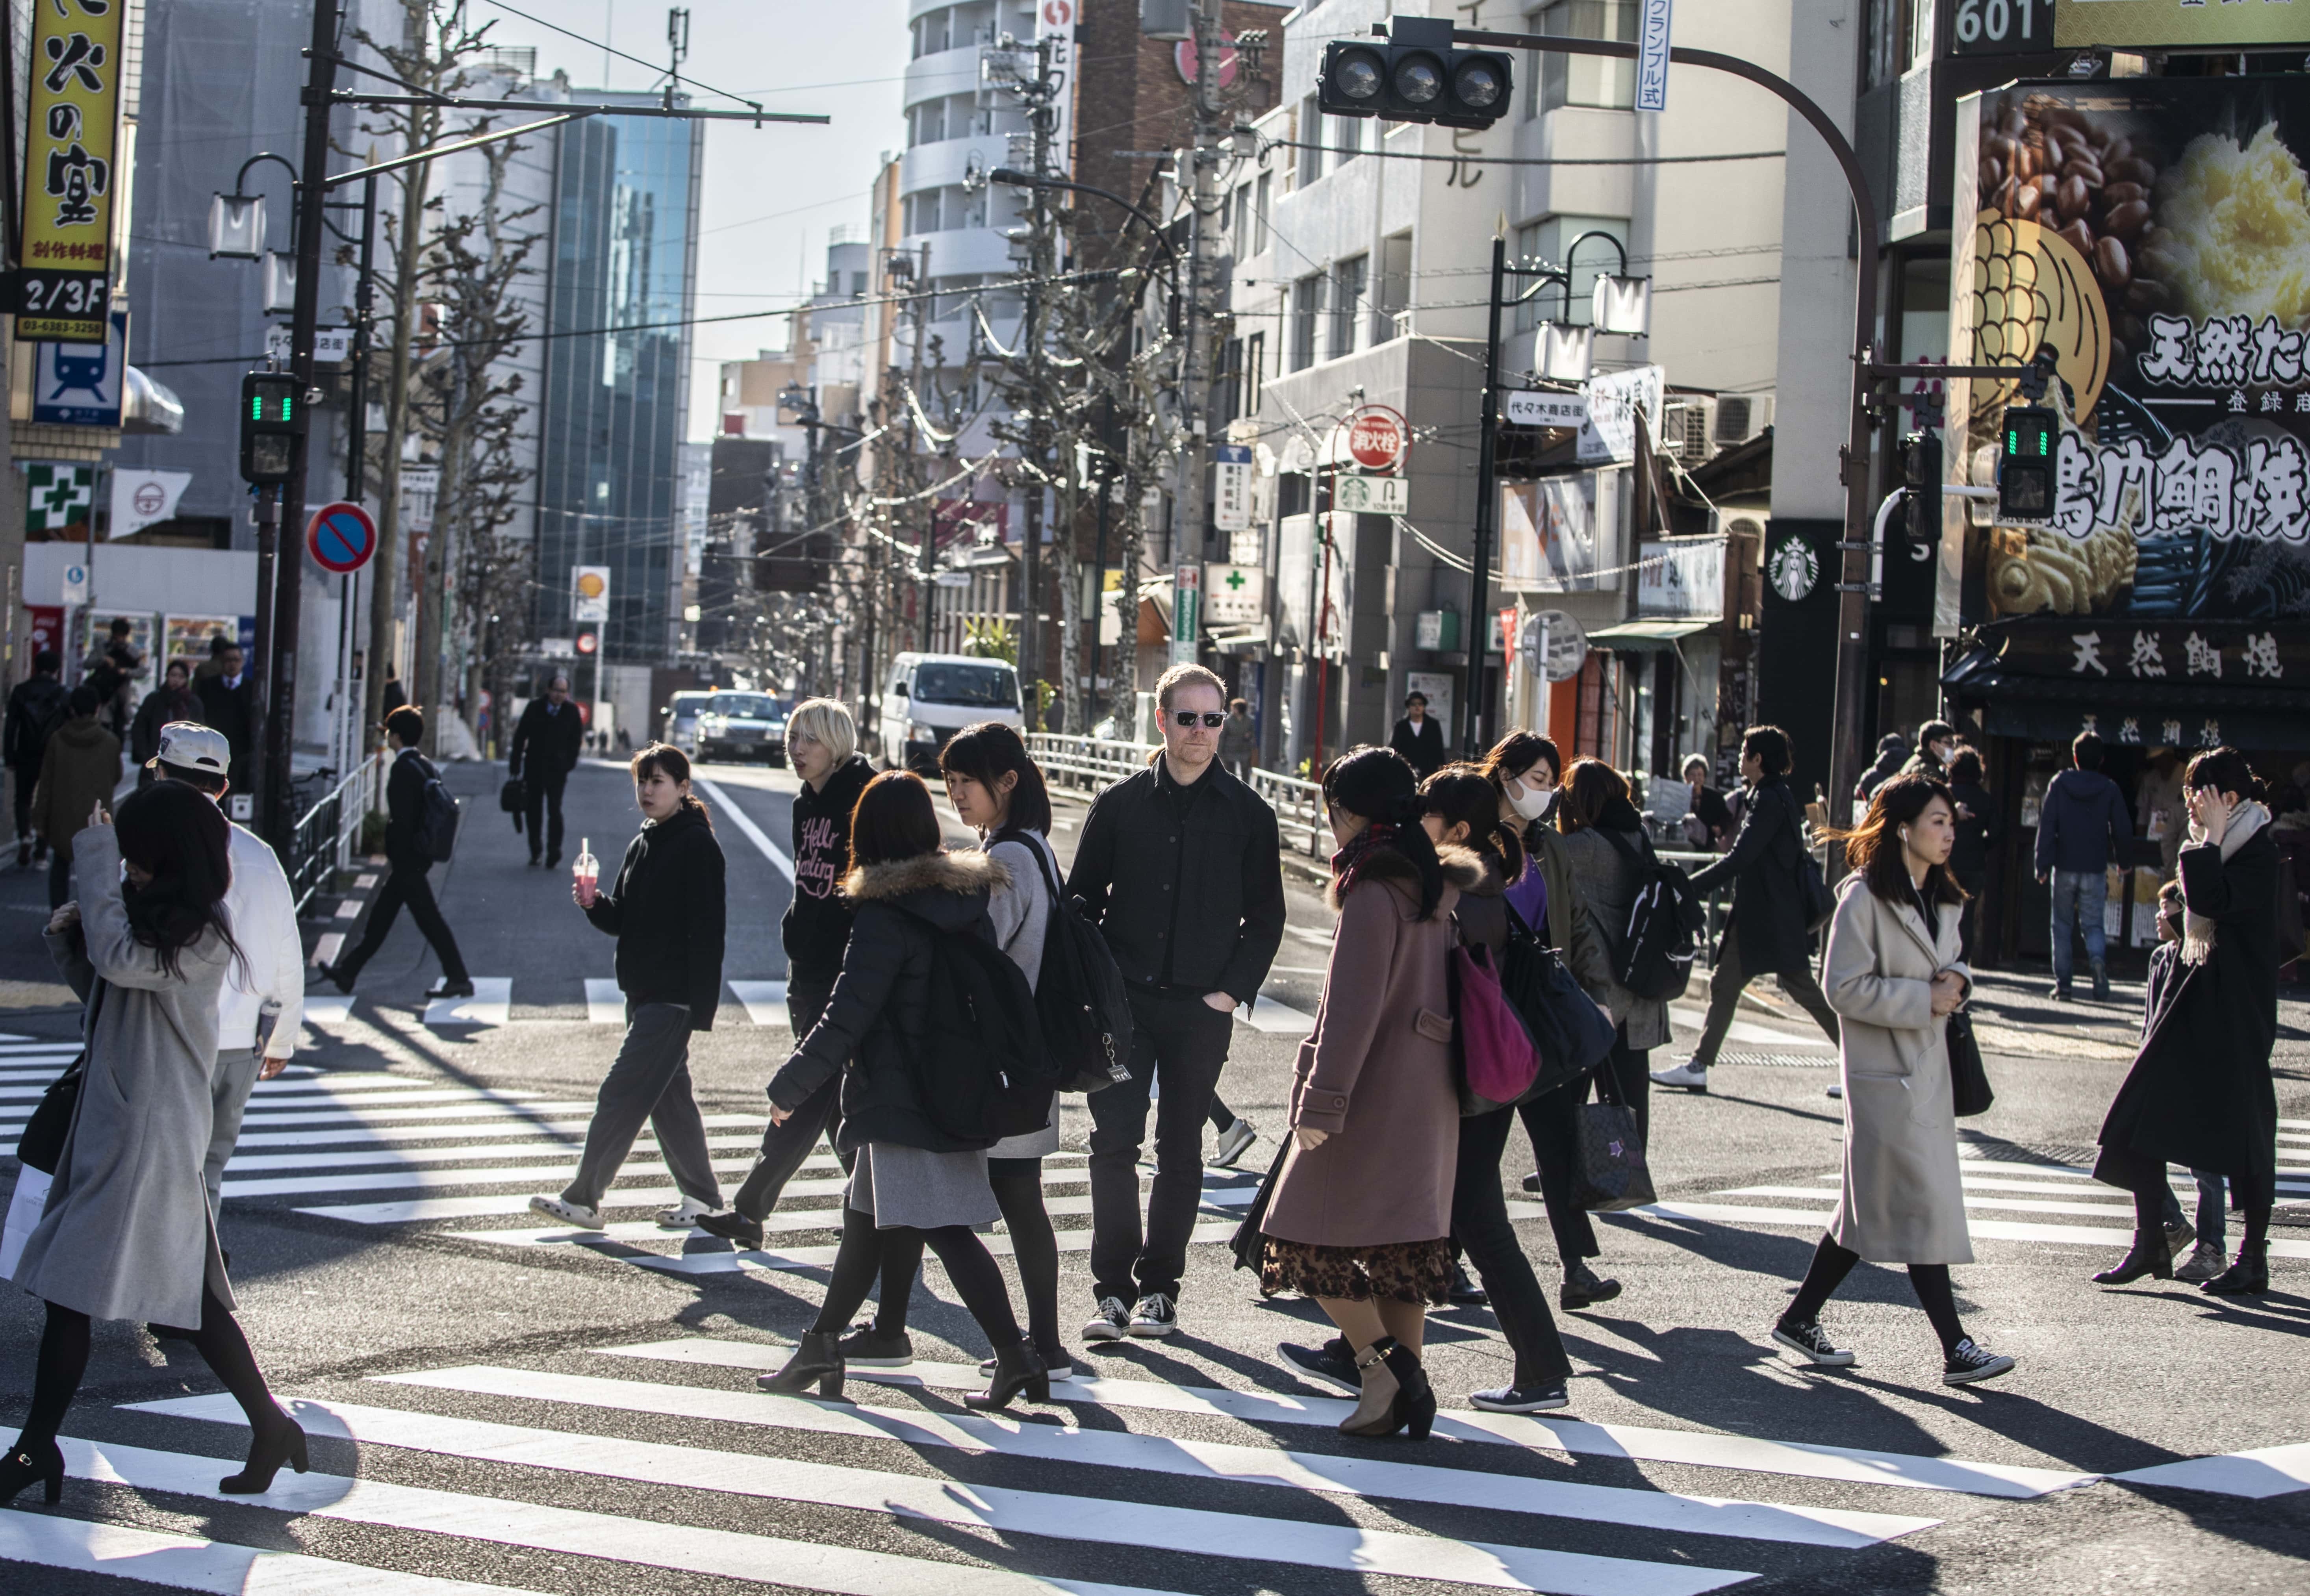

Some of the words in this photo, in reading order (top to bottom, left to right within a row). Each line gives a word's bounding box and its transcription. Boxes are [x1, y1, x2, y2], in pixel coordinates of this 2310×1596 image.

[1957, 0, 2054, 42] 601
[26, 278, 105, 313] 2/3F
[270, 334, 344, 350] 代々店街
[2138, 314, 2310, 386] 天然た
[1511, 400, 1583, 417] 代々木商店街
[1352, 430, 1398, 453] 消火栓
[2071, 630, 2283, 678] 天然鯛焼
